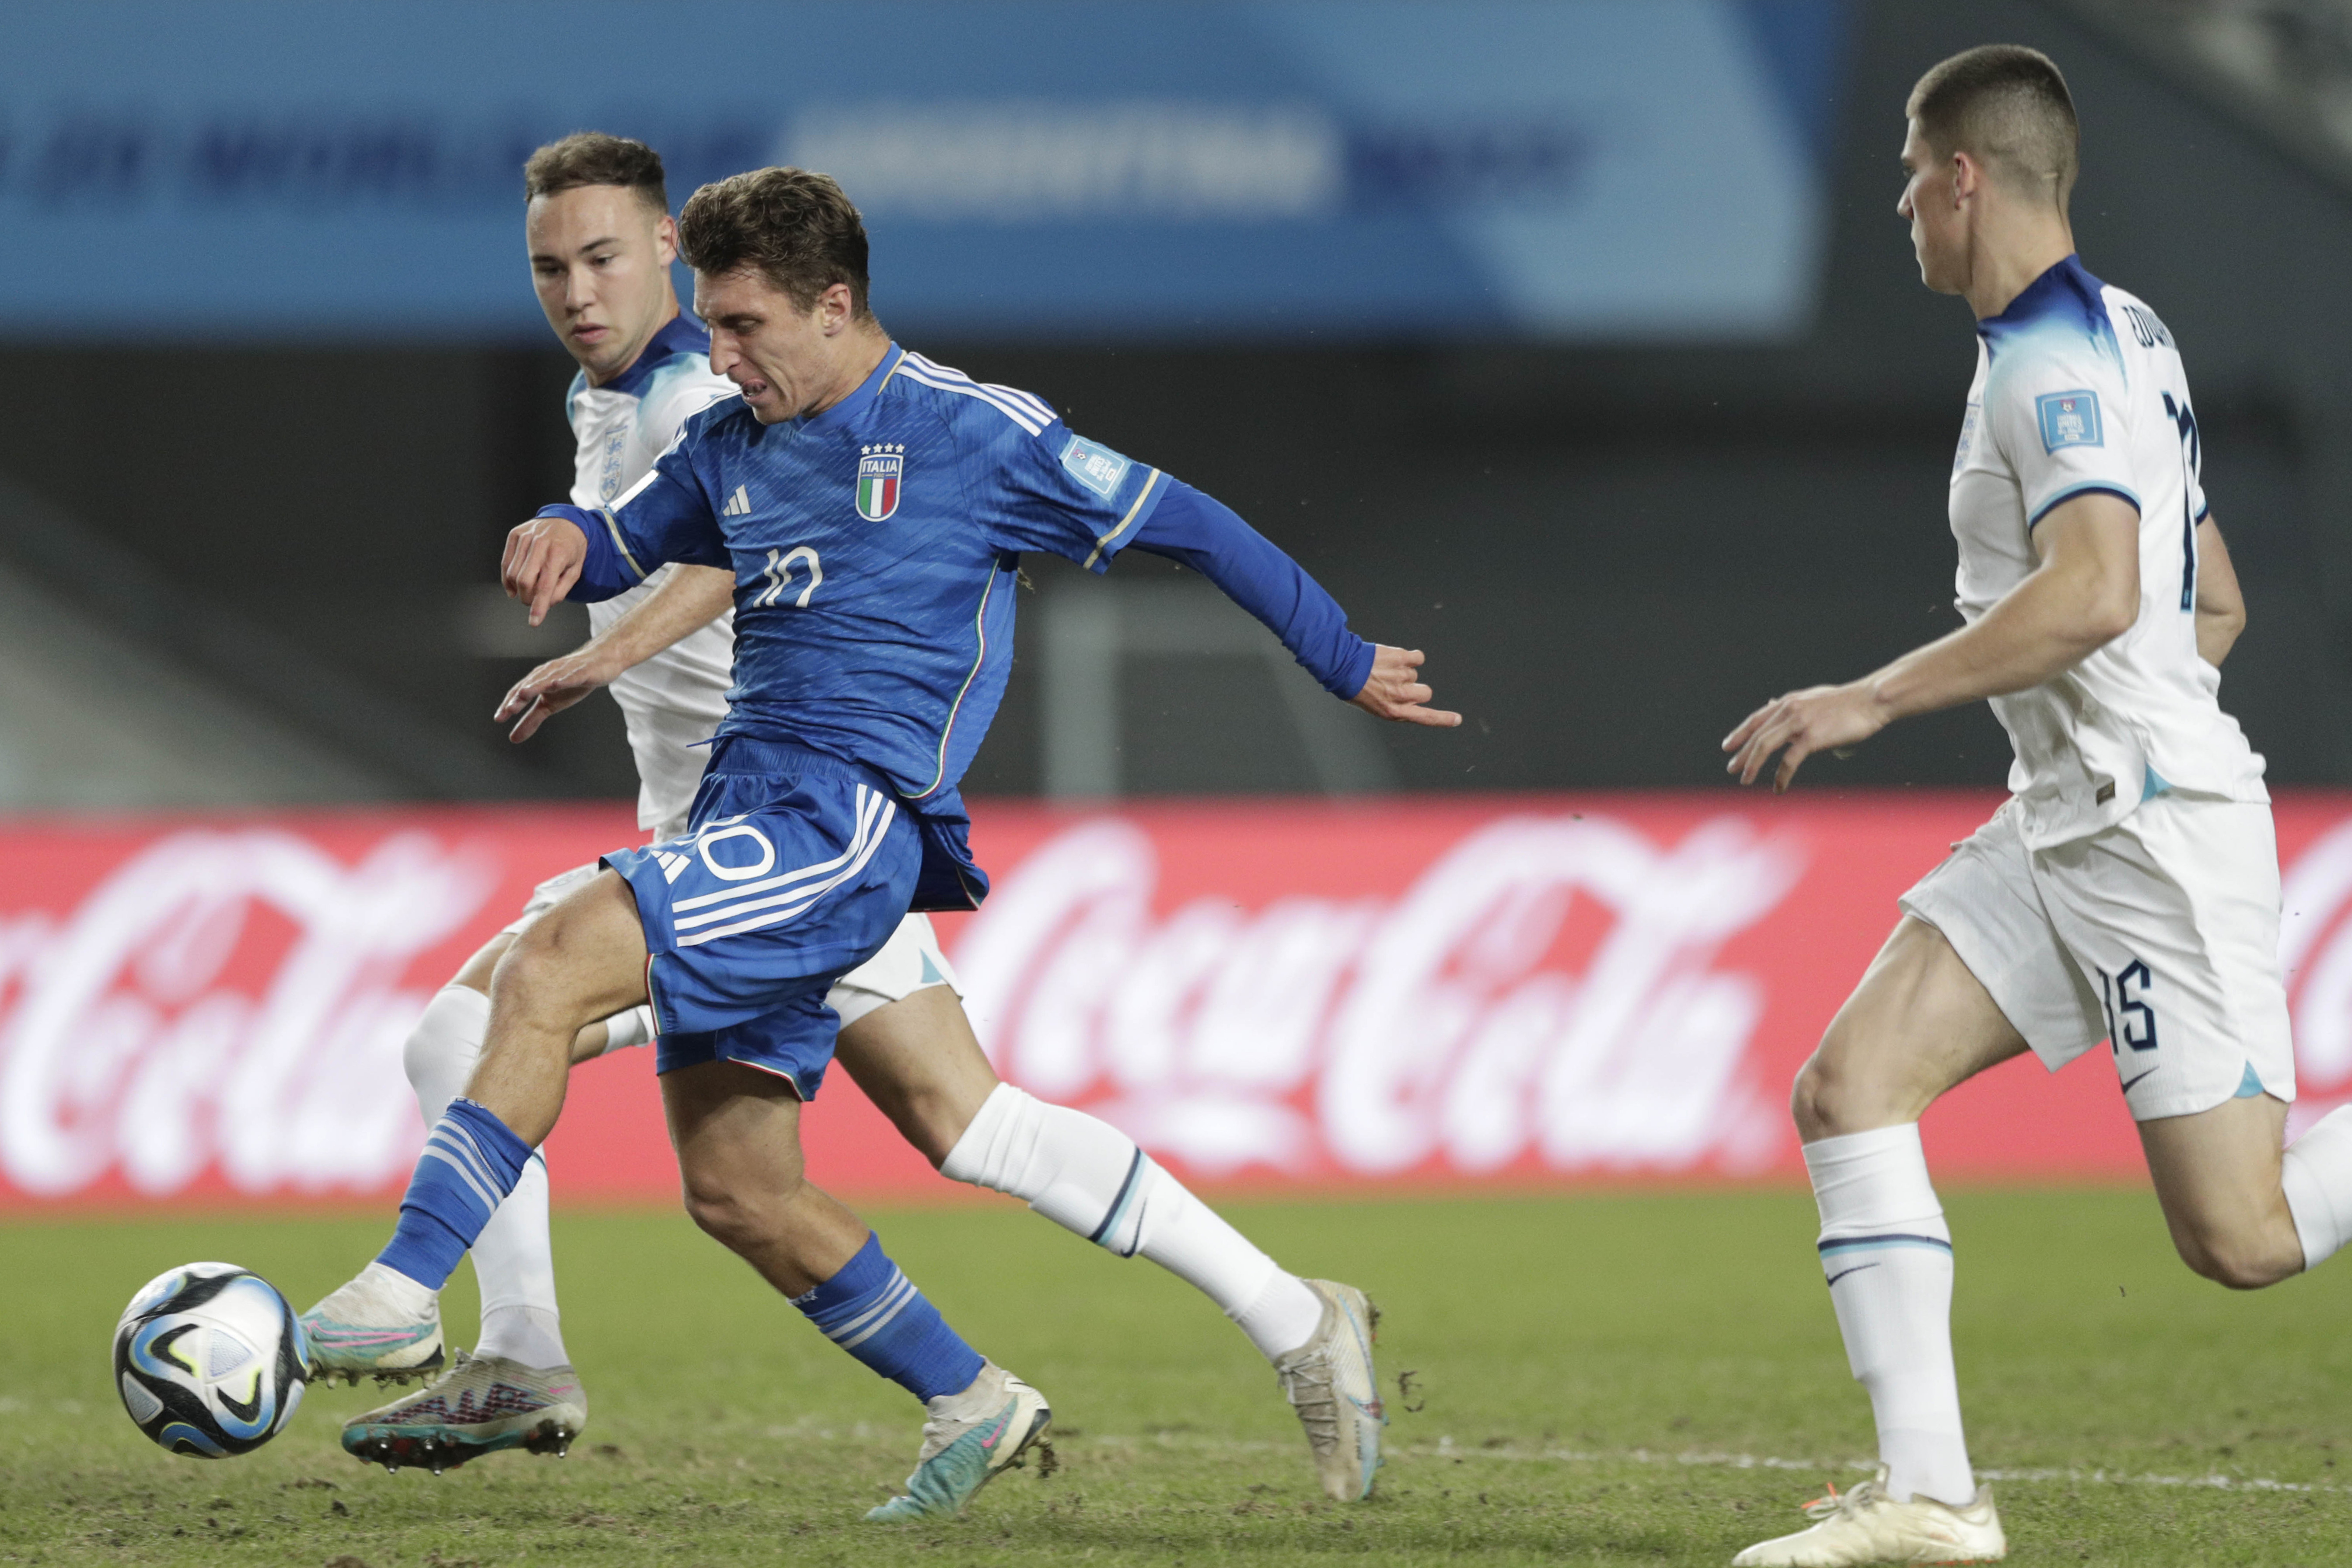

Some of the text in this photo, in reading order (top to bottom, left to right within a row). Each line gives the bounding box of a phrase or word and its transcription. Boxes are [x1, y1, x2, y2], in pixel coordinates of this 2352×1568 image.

[861, 460, 898, 473] ITALIA
[753, 546, 823, 608] 10
[2095, 958, 2158, 1055] 15
